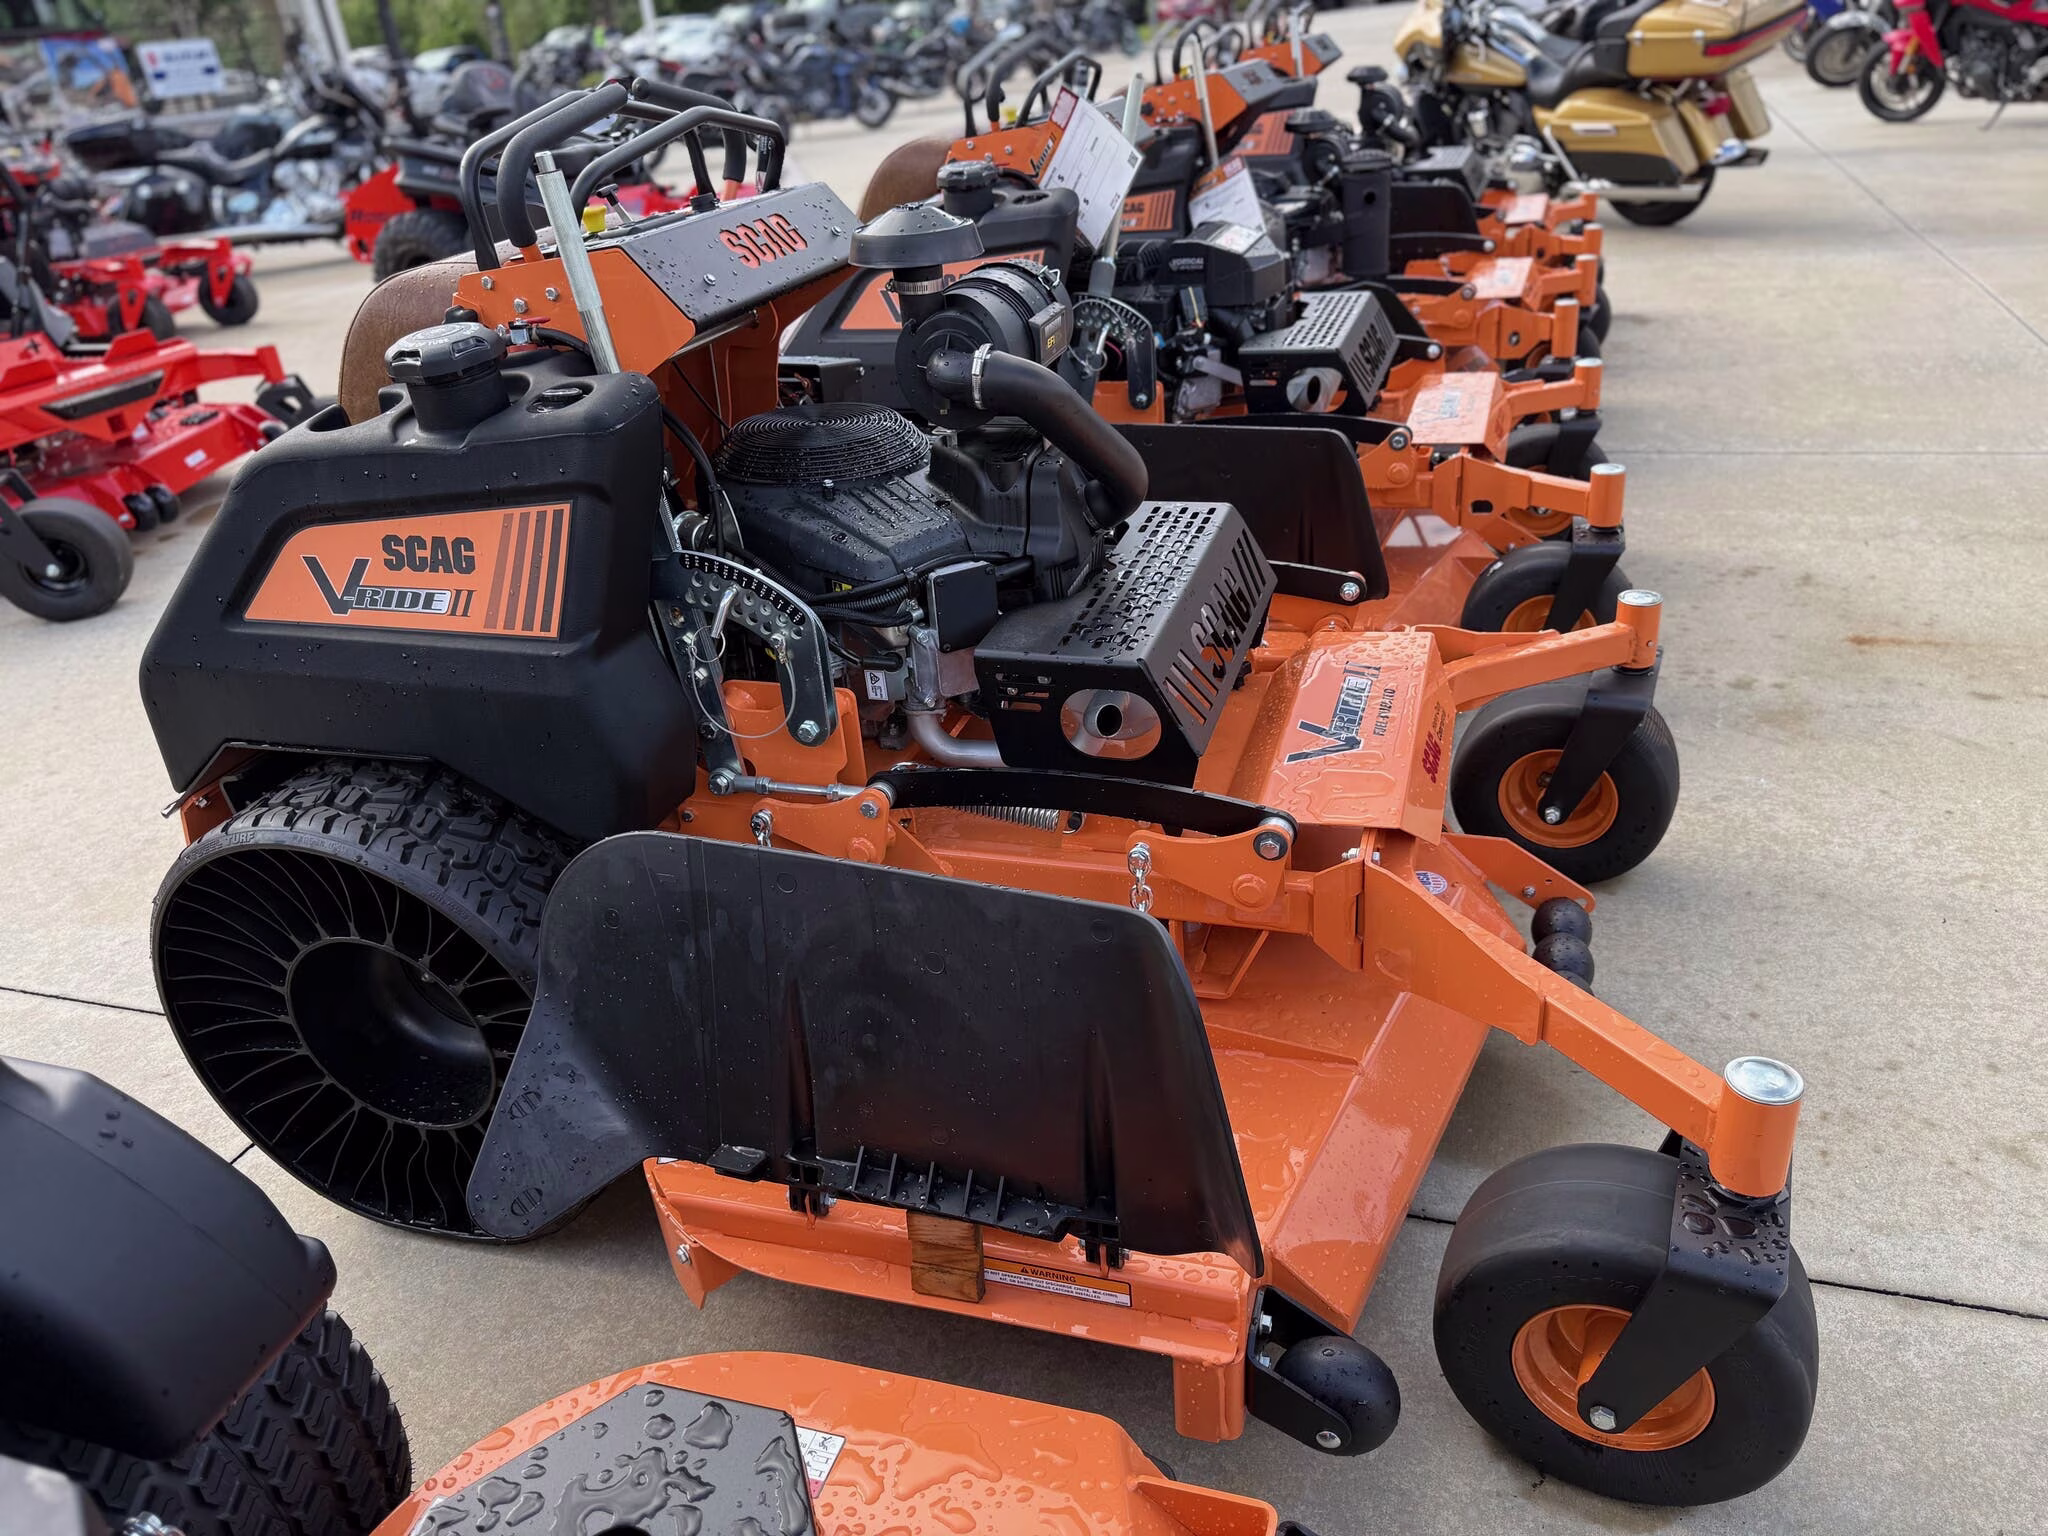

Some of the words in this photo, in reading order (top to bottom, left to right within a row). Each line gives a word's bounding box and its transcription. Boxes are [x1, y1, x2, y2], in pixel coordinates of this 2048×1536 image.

[1122, 202, 1145, 213] CAG
[719, 212, 808, 270] SCAG
[381, 534, 476, 574] SCAG
[448, 589, 477, 617] II
[1190, 567, 1251, 682] SCAG
[225, 831, 256, 845] TURF
[1030, 1268, 1077, 1283] WARNING
